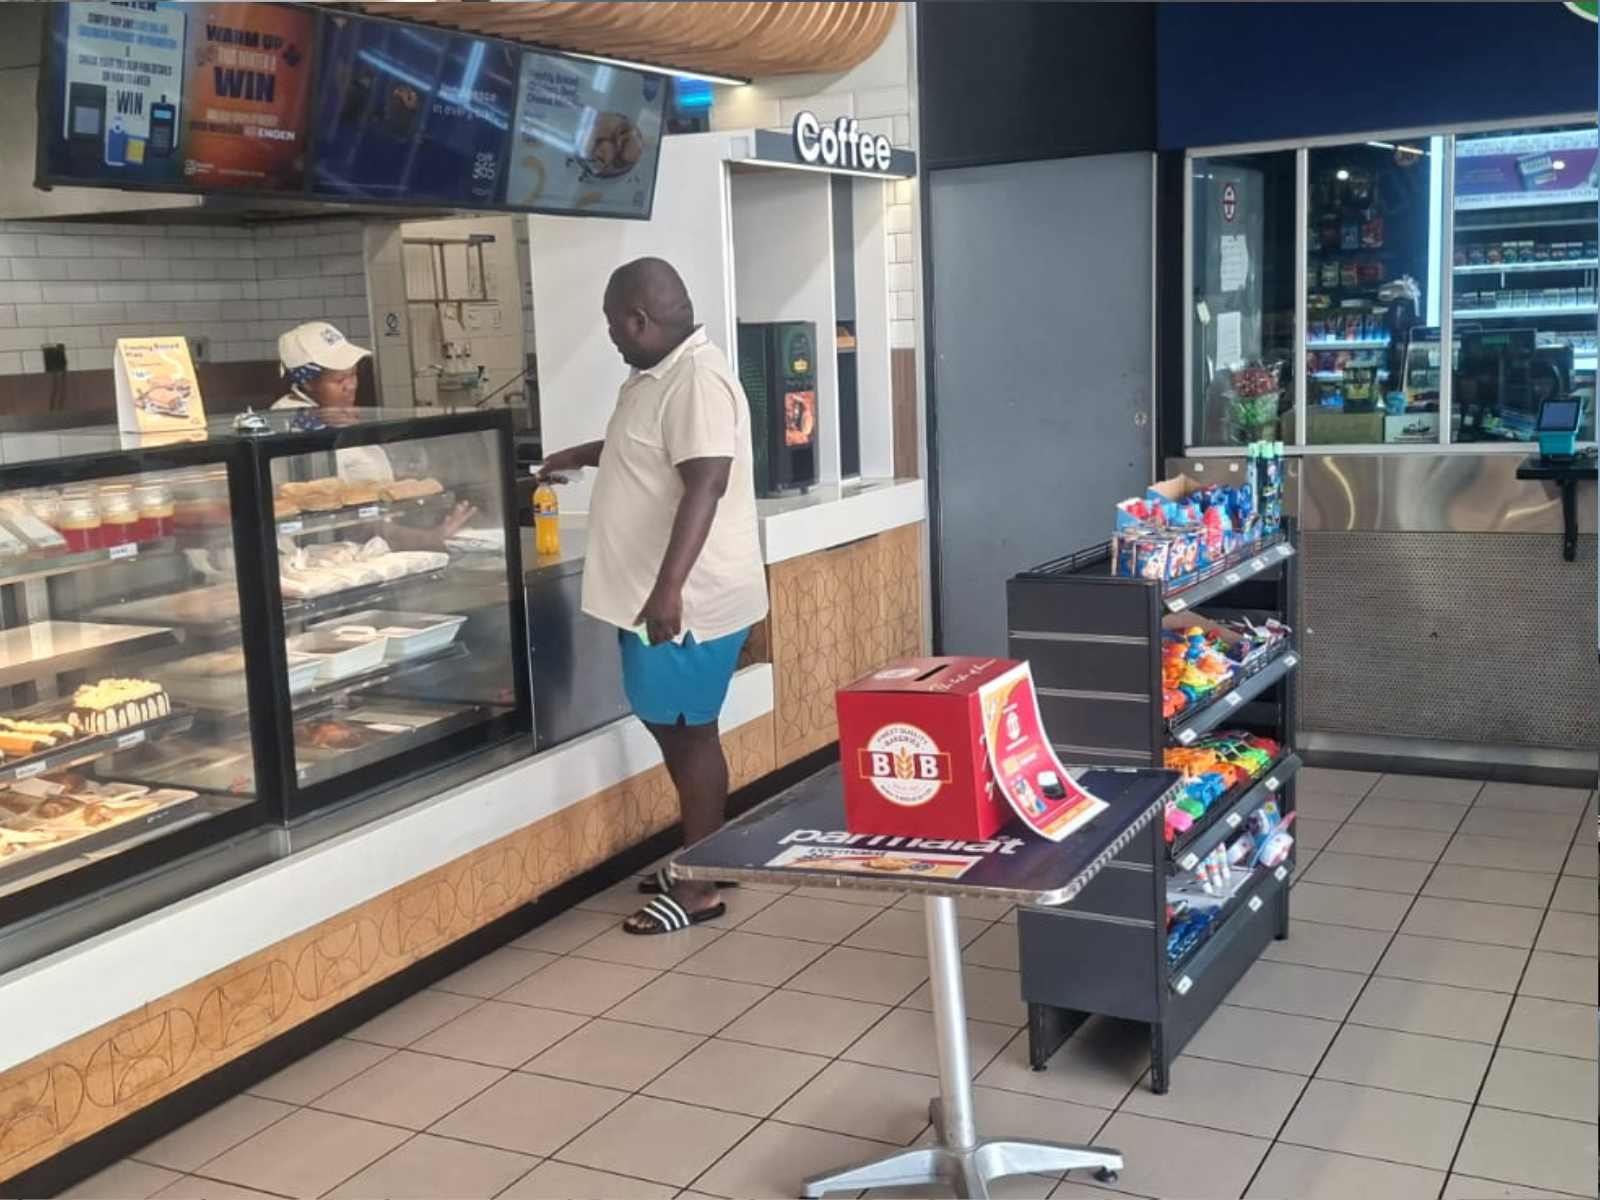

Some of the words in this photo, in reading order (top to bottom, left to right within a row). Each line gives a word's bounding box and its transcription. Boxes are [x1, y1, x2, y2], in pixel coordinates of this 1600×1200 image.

[206, 25, 259, 48] WARM
[262, 33, 283, 51] UP
[214, 66, 276, 104] WIN
[116, 89, 144, 116] WIN
[258, 128, 295, 141] ENGEN
[793, 110, 892, 171] Coffee
[872, 753, 891, 777] B
[919, 755, 939, 779] B
